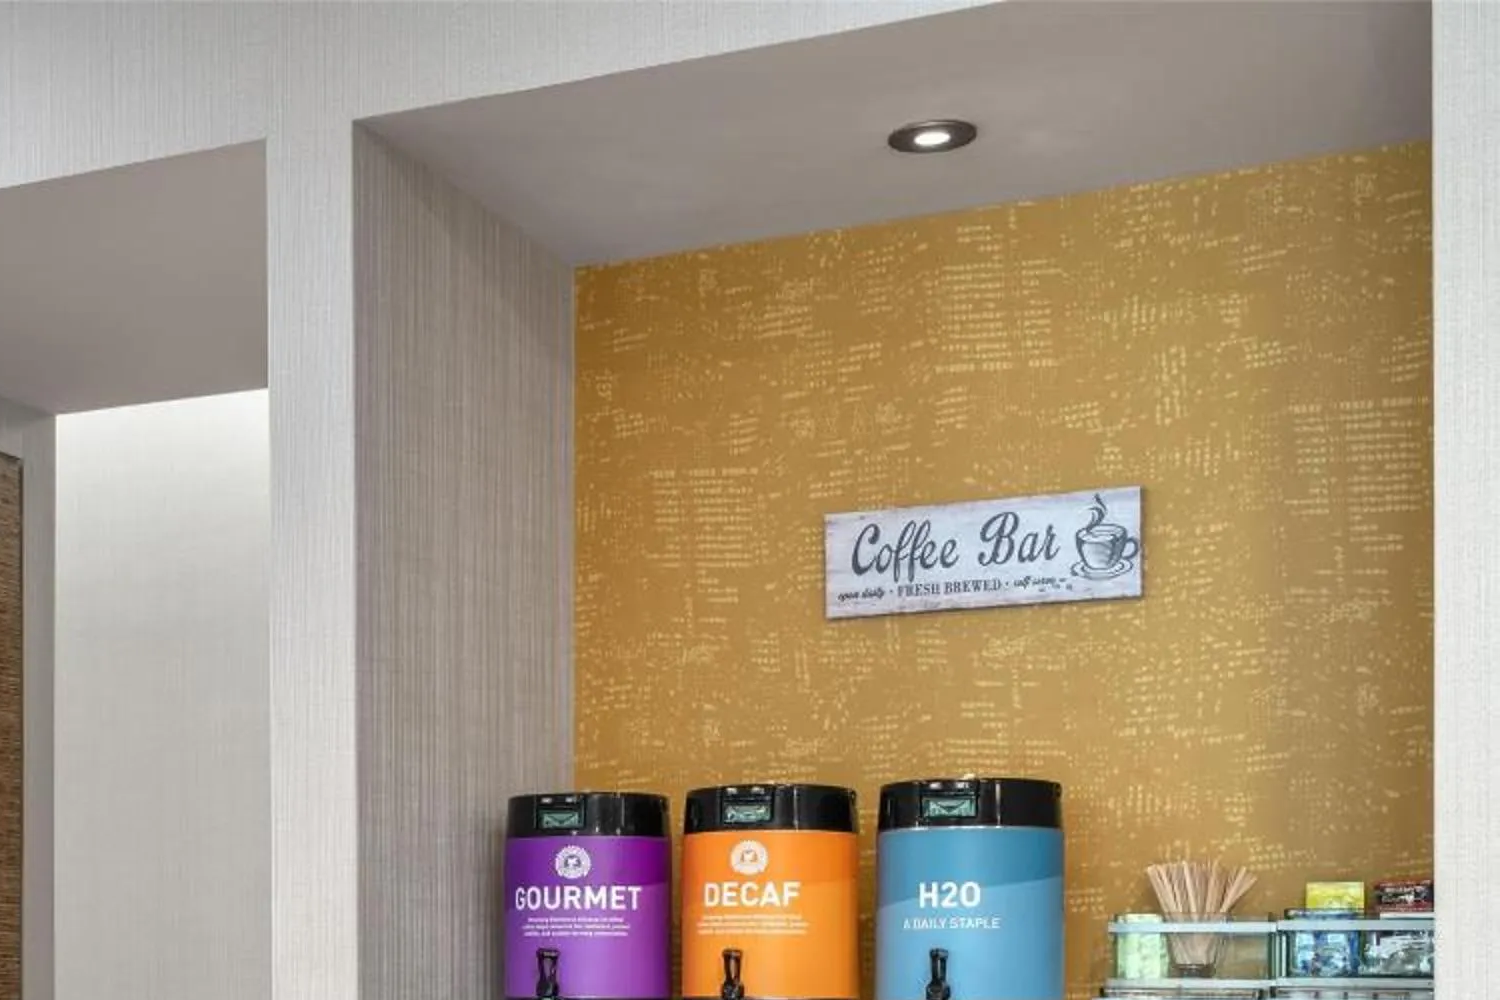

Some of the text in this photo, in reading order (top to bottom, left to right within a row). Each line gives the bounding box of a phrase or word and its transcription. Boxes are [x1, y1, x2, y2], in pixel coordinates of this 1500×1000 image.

[851, 511, 1062, 583] Coffee Bar
[897, 583, 941, 597] FRESH
[943, 578, 1001, 595] BREWED
[515, 885, 642, 911] GOURMET
[704, 881, 801, 907] DECAF
[903, 917, 1001, 929] A DAILY STAPLE
